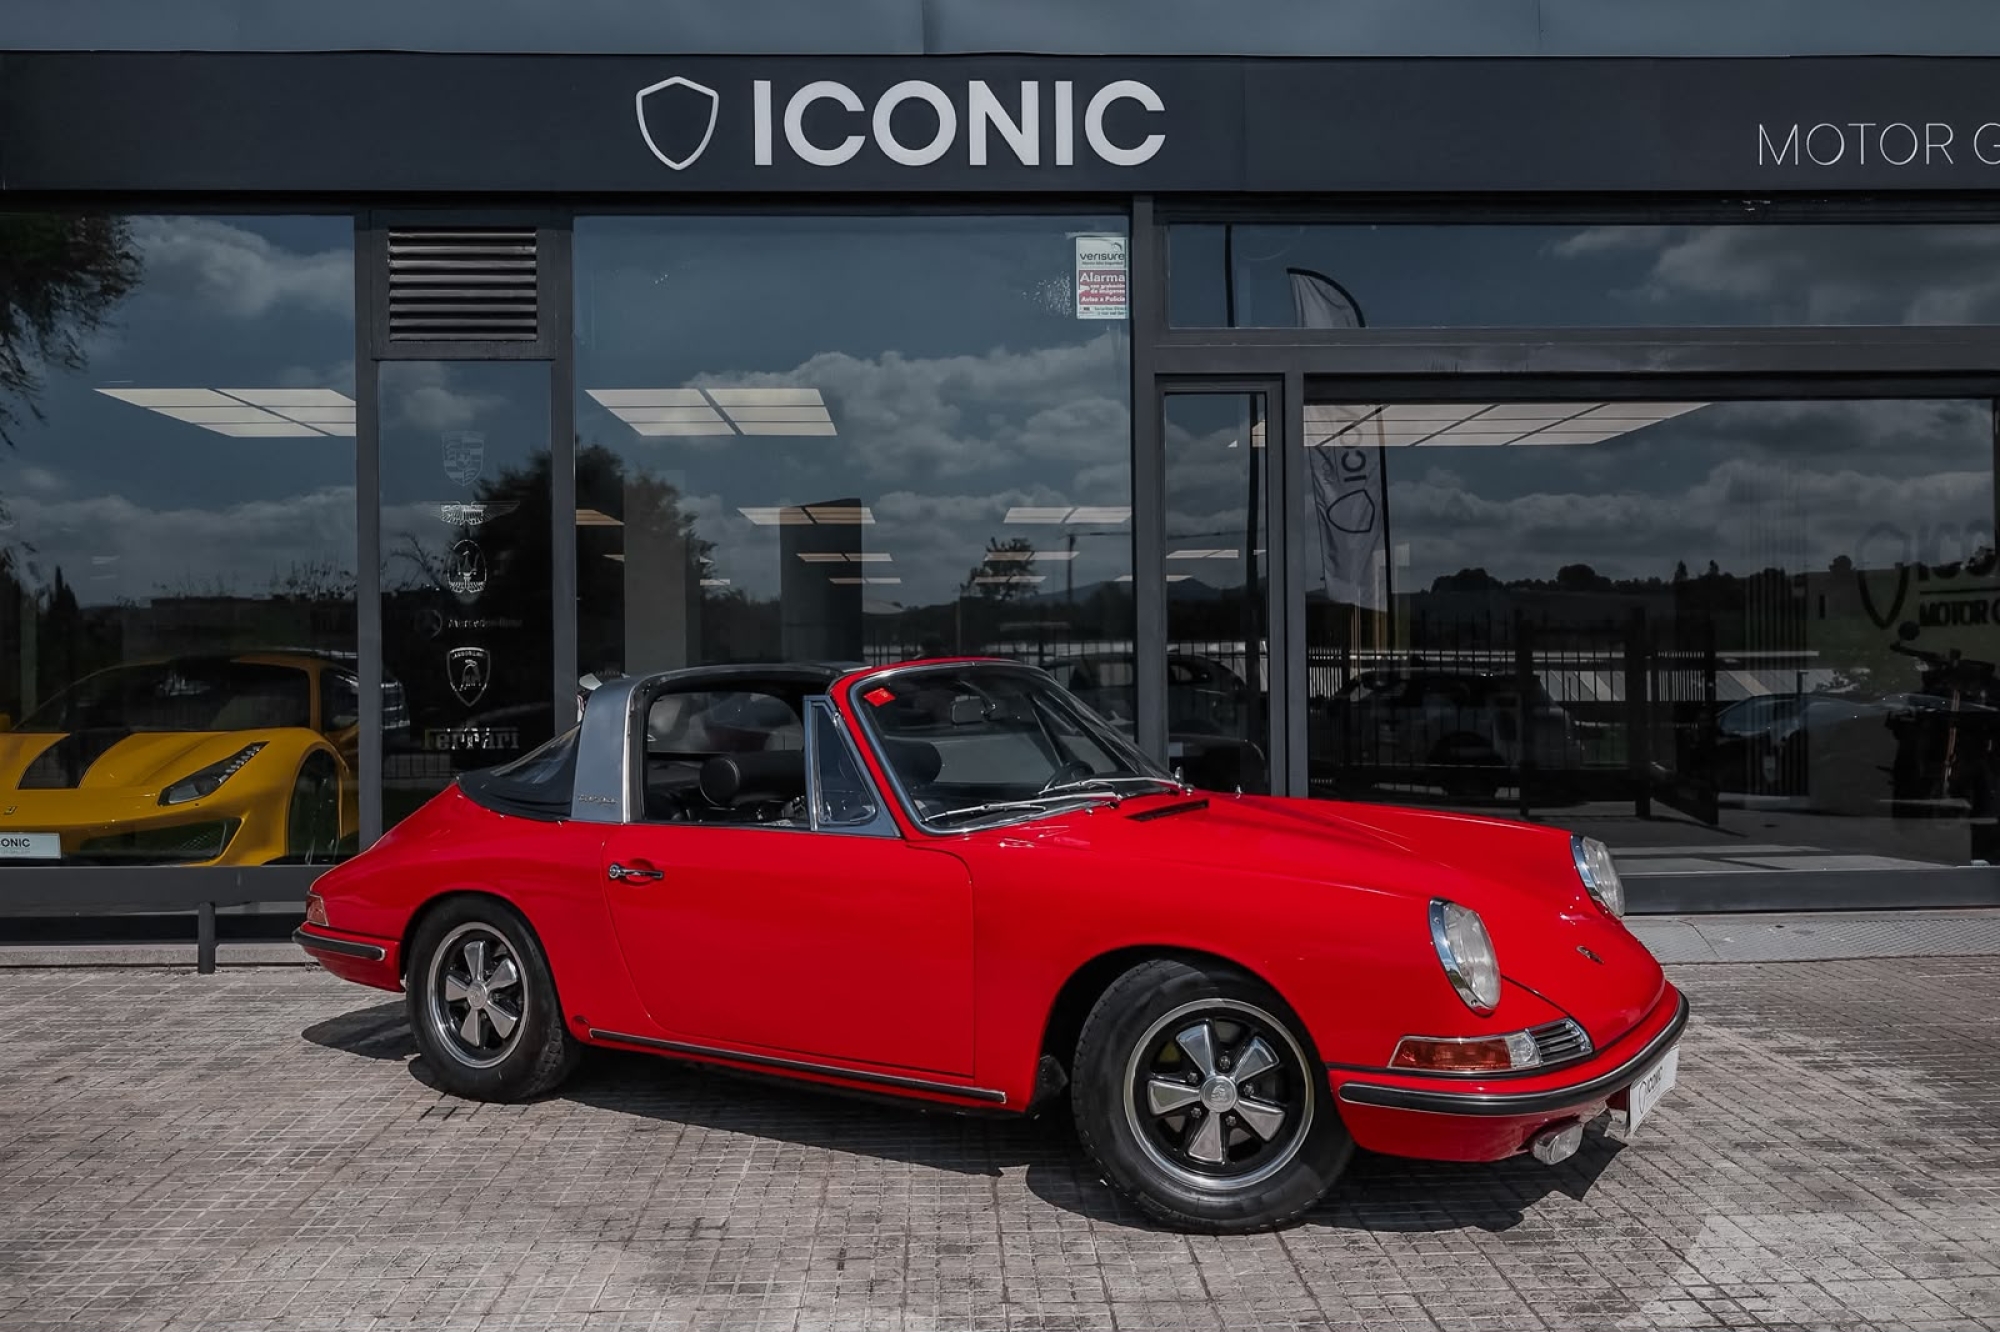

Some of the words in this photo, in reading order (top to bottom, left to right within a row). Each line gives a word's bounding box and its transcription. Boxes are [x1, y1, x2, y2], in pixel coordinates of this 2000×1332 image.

[754, 79, 1166, 166] ICONIC
[1758, 122, 1954, 166] MOTOR
[1080, 253, 1125, 261] verisure
[1080, 272, 1125, 282] Alarma
